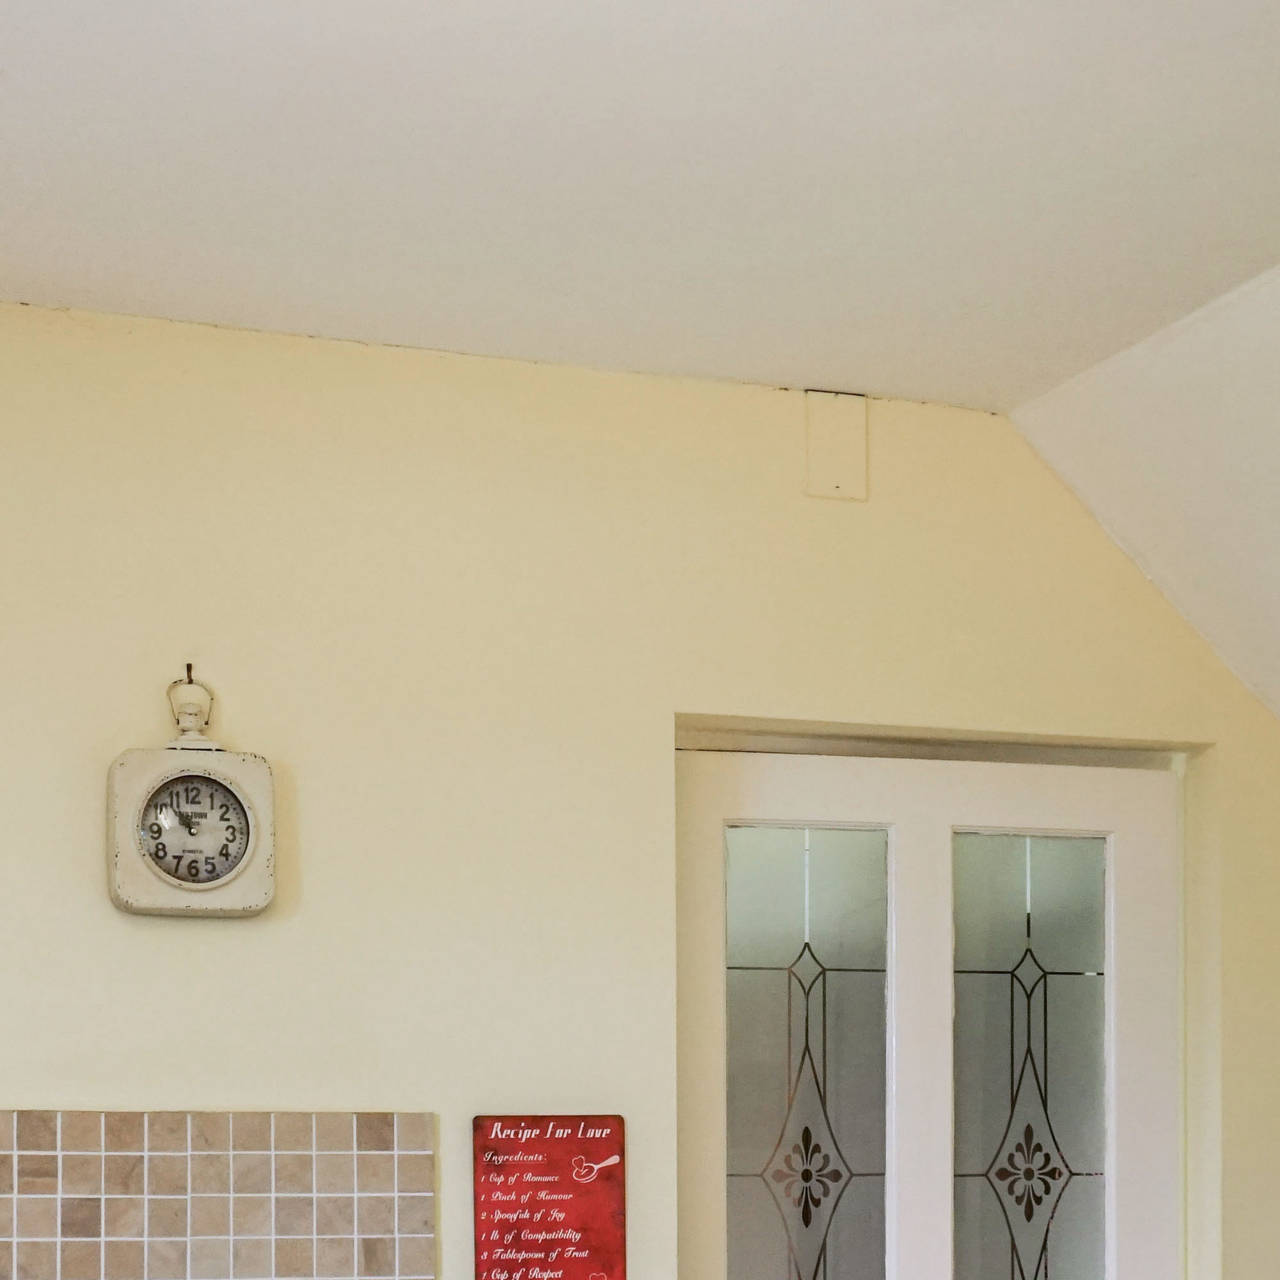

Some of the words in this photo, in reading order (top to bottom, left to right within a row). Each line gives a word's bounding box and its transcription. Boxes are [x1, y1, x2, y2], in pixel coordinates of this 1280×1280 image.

[184, 786, 201, 805] 12
[209, 792, 214, 810] 1
[219, 804, 231, 821] 2
[149, 822, 162, 840] 9
[225, 825, 237, 843] 3
[155, 842, 167, 860] 8
[219, 844, 231, 861] 4
[172, 855, 184, 874] 7
[187, 859, 199, 877] 6
[204, 856, 216, 874] 5
[488, 1121, 540, 1143] Recipe
[544, 1121, 572, 1139] For
[577, 1121, 611, 1139] Love
[489, 1173, 505, 1185] Cup
[508, 1173, 520, 1185] of
[522, 1172, 559, 1182] Romance
[491, 1191, 516, 1201] Pinch
[520, 1191, 533, 1204] of
[536, 1190, 573, 1200] Humour
[533, 1208, 546, 1222] of
[547, 1207, 566, 1222] Joy
[490, 1229, 499, 1241] lb
[504, 1229, 517, 1244] of
[520, 1228, 582, 1244] Compatibility
[492, 1248, 545, 1262] Tablespoons
[548, 1248, 561, 1262] of
[564, 1247, 589, 1258] Trust
